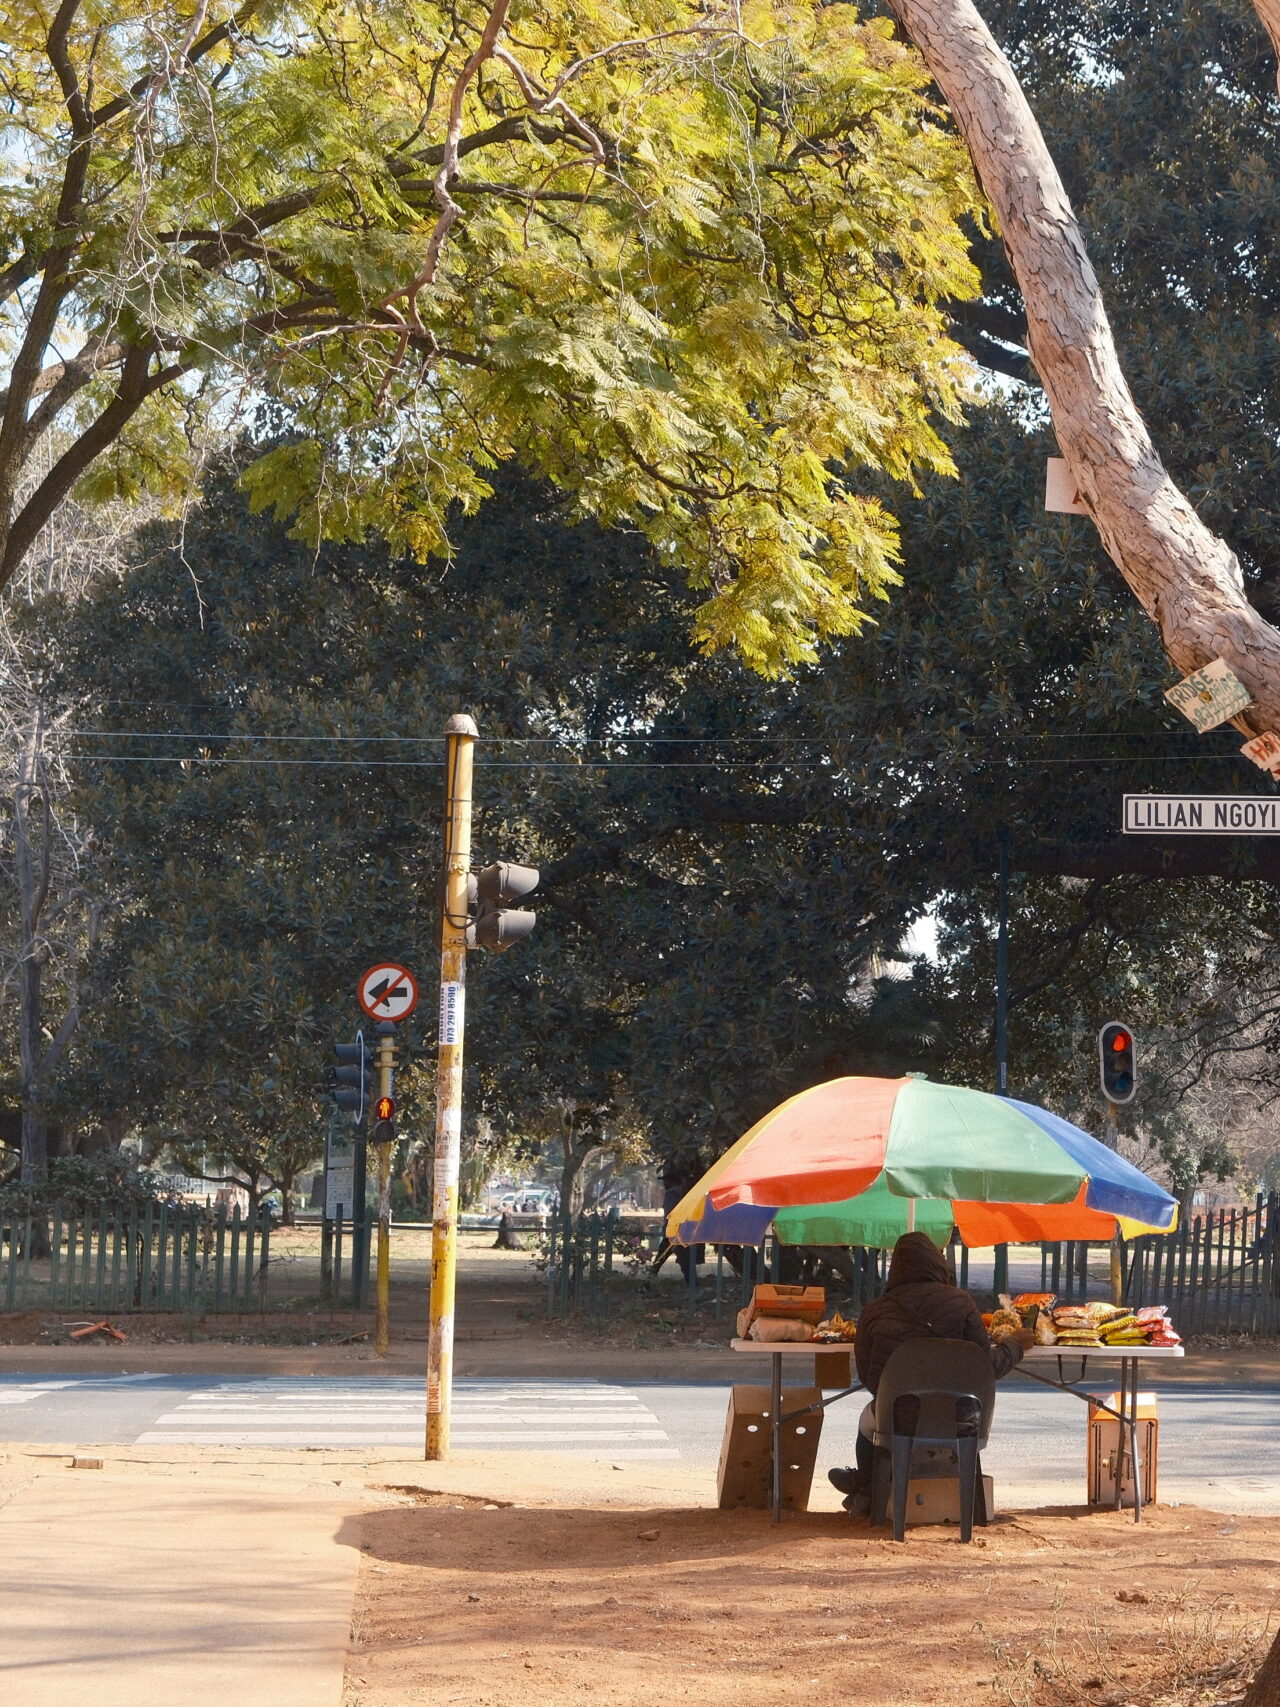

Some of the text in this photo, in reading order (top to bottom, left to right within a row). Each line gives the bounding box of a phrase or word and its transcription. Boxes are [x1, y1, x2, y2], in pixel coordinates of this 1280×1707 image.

[1168, 669, 1214, 712] FRIDGE
[1134, 802, 1203, 827] LILIAN
[1214, 803, 1276, 828] NGOYI
[447, 986, 456, 1043] 073 297 8590
